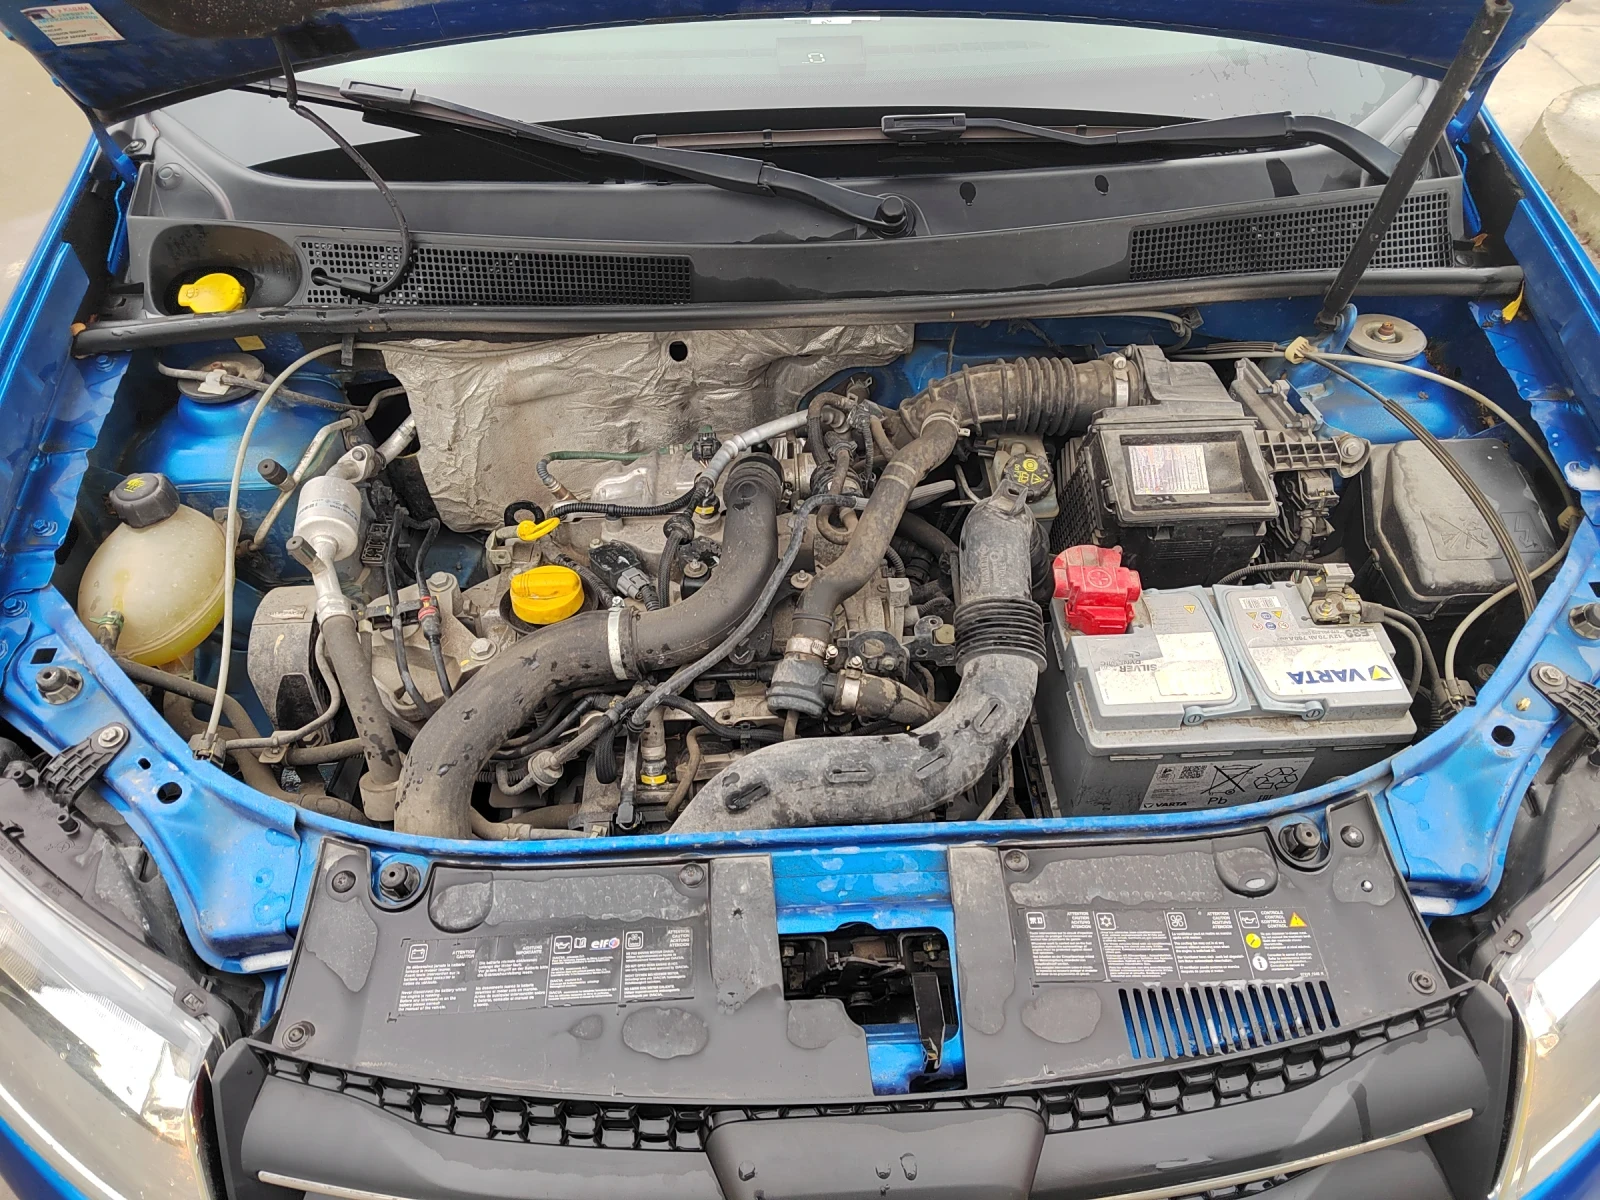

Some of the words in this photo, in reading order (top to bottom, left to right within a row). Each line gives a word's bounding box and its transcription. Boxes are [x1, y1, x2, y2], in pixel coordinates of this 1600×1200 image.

[1344, 628, 1370, 638] E39
[1119, 664, 1158, 672] SILVER
[1286, 668, 1367, 684] VARTA
[1207, 797, 1227, 805] Pb
[590, 939, 610, 949] elf
